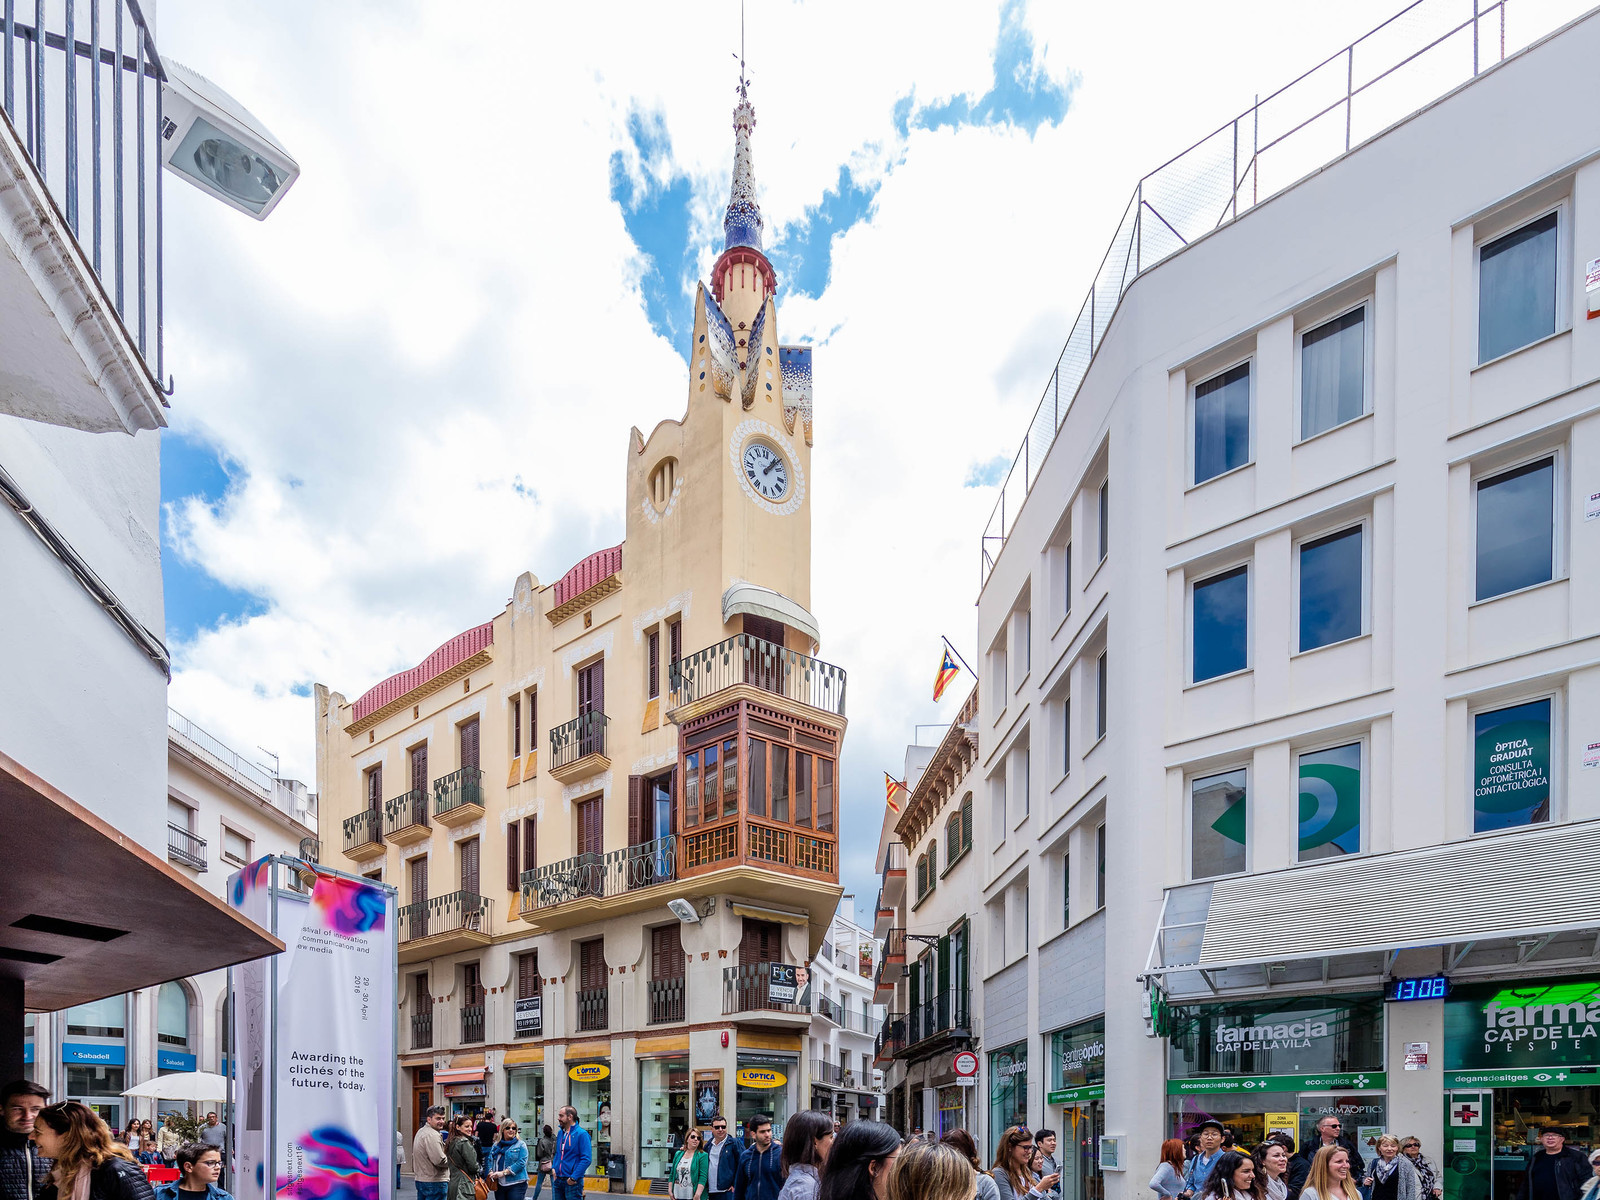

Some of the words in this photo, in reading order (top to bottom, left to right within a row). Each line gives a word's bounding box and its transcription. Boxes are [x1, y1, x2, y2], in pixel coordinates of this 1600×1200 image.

[1495, 739, 1528, 752] ÒPTICA
[1490, 747, 1534, 763] GRADUAT
[1489, 760, 1533, 775] CONSULTA
[1481, 768, 1538, 786] OPTOMÈTRICA
[1475, 777, 1548, 797] CONTACTOLÒGICA
[333, 932, 368, 945] innovation
[309, 946, 333, 954] media
[362, 977, 370, 987] 29
[362, 992, 369, 1003] 30
[360, 1003, 368, 1021] April
[1215, 1018, 1328, 1043] farmacia
[1484, 1028, 1529, 1042] CAP
[1533, 1026, 1563, 1040] DE
[1568, 1024, 1598, 1039] LA
[1215, 1042, 1241, 1052] CAP
[1243, 1041, 1260, 1051] DE
[1262, 1040, 1279, 1050] LA
[1282, 1038, 1312, 1048] VILA
[1485, 1040, 1580, 1053] DESDE
[77, 1052, 110, 1060] Sabadell
[165, 1058, 185, 1067] Sabadell
[291, 1051, 346, 1065] Awarding
[349, 1055, 364, 1066] the
[289, 1064, 334, 1076] clichés
[337, 1068, 348, 1076] of
[350, 1069, 365, 1078] the
[291, 1078, 333, 1090] future,
[338, 1080, 366, 1092] today.
[1180, 1081, 1239, 1090] decanosdesitges
[1305, 1078, 1350, 1086] ecoceutics
[1455, 1074, 1528, 1084] degansdesitges
[1318, 1105, 1384, 1114] FARMAOPTICS
